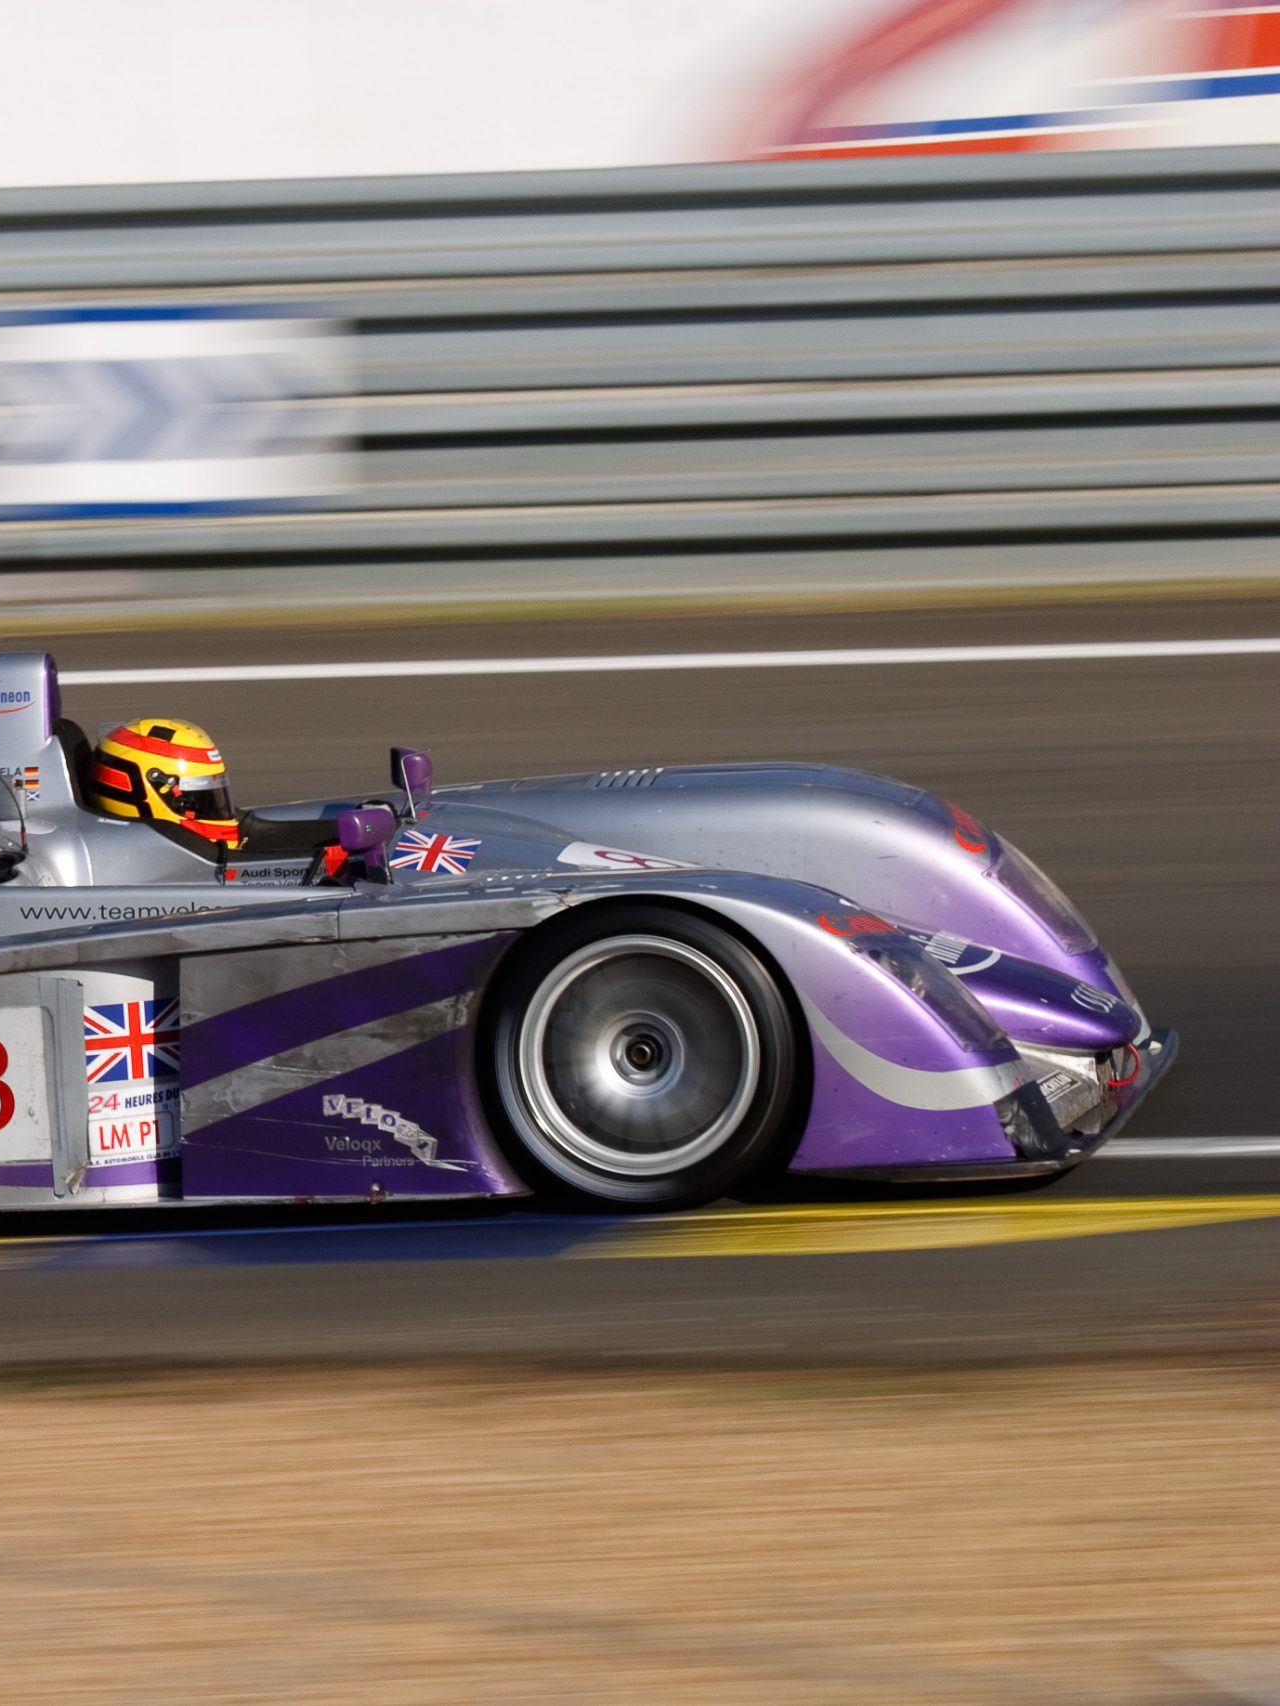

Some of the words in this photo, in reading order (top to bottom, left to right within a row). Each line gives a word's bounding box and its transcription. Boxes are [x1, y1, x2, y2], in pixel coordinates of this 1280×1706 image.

[241, 868, 271, 878] Audi
[88, 1093, 118, 1114] 24
[124, 1091, 164, 1109] HEURES
[165, 1087, 180, 1100] DU
[139, 1119, 160, 1147] P1
[324, 1136, 382, 1153] Veloqx
[362, 1155, 414, 1167] Partners
